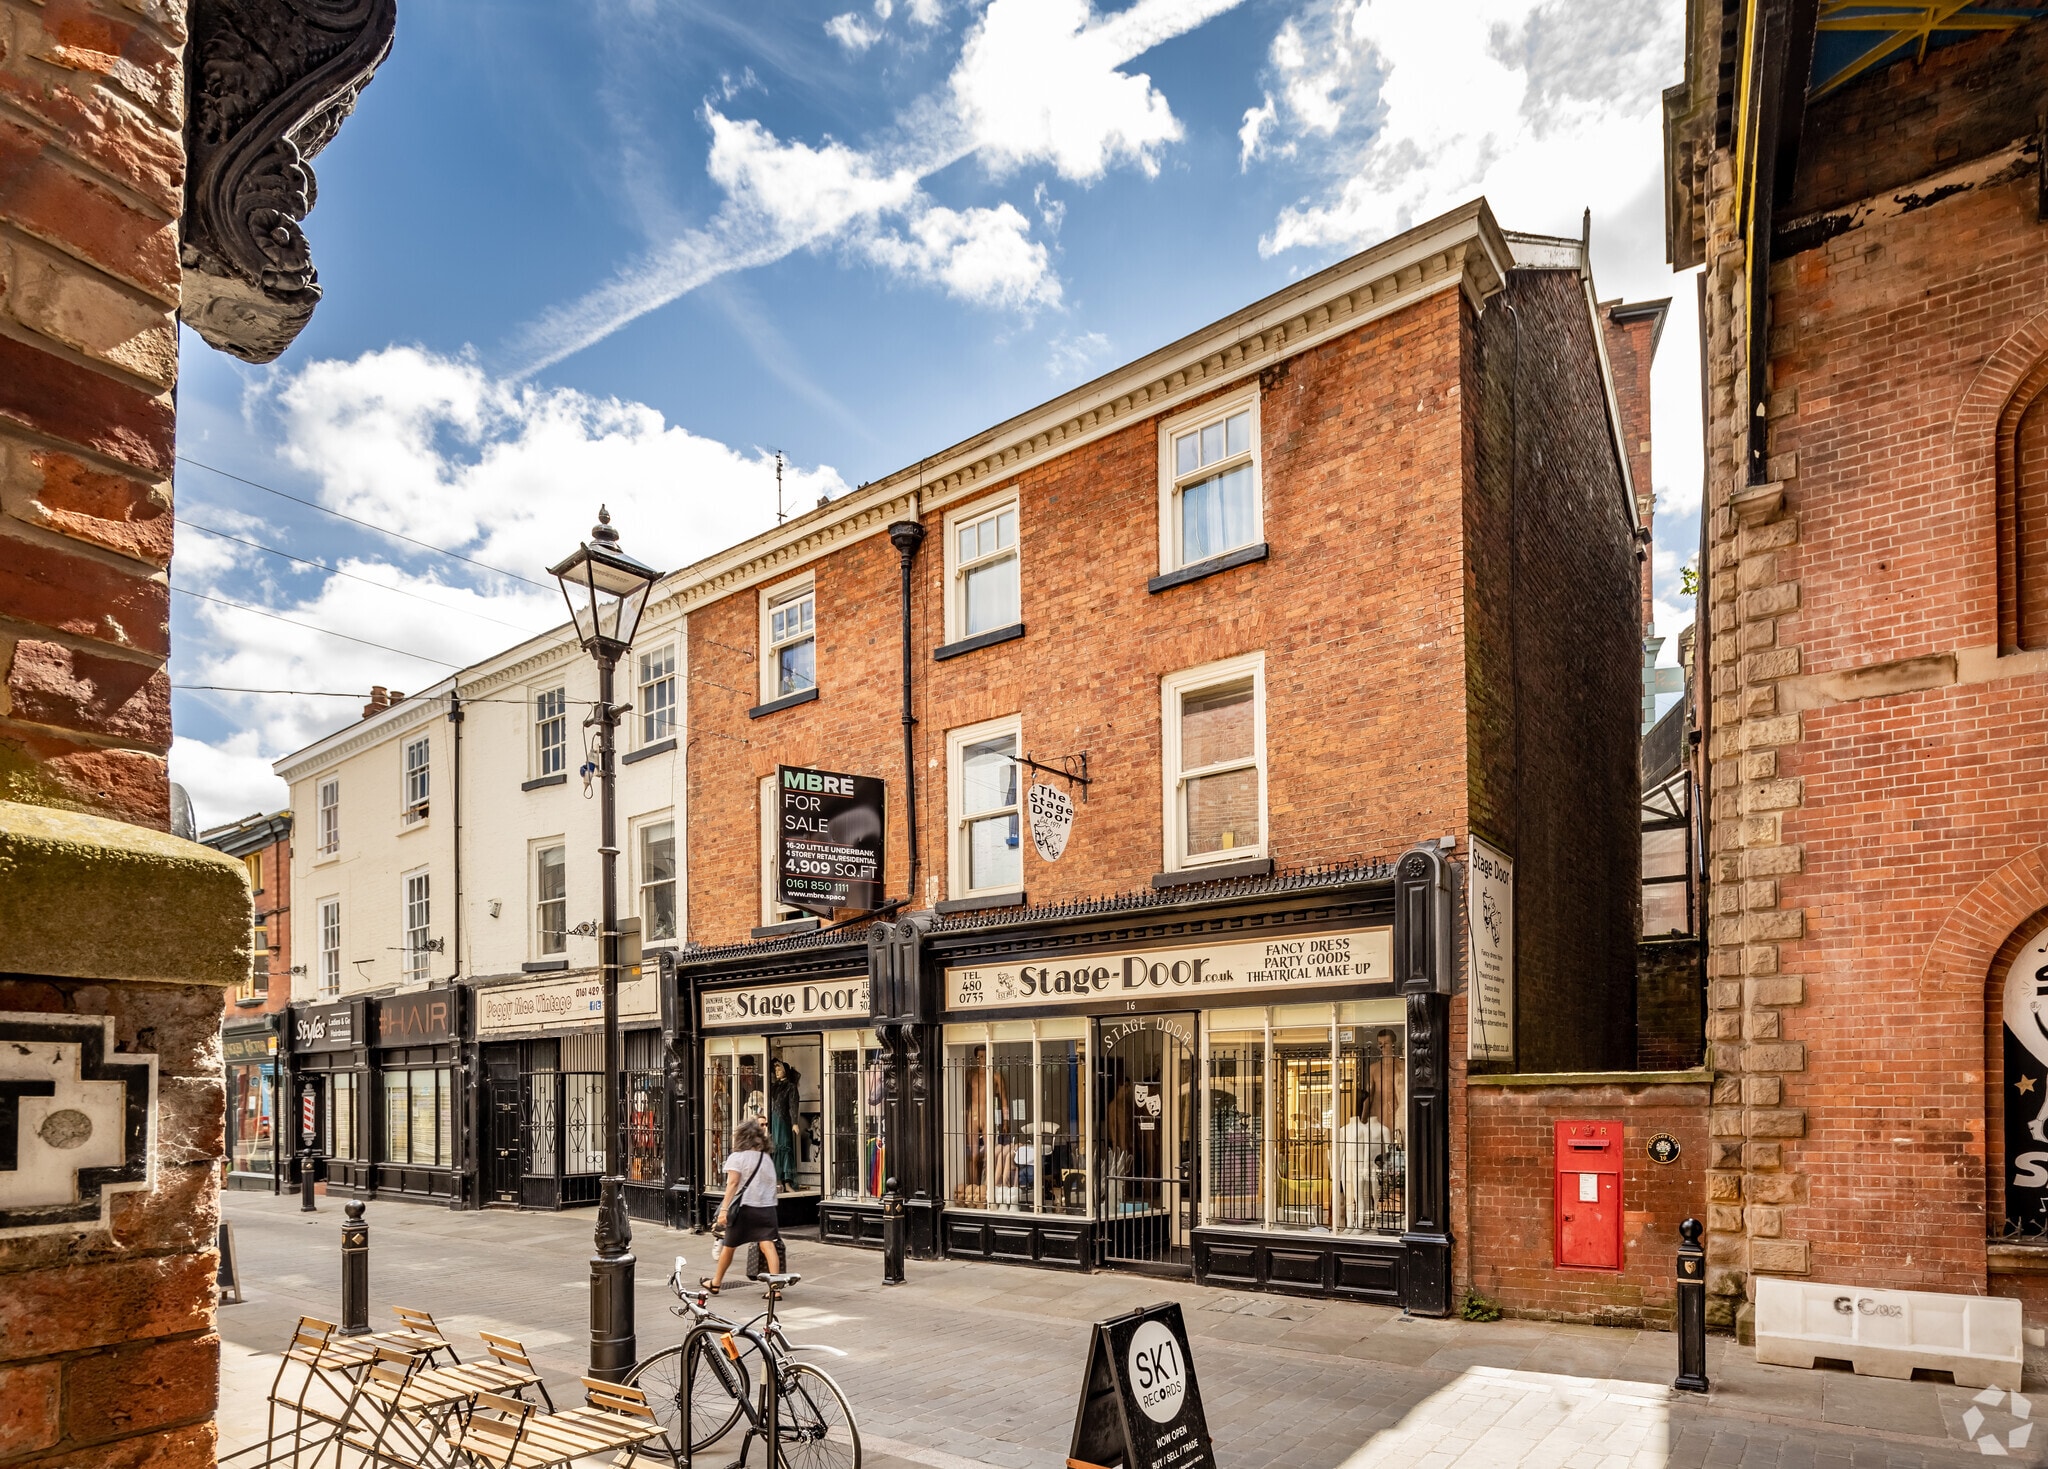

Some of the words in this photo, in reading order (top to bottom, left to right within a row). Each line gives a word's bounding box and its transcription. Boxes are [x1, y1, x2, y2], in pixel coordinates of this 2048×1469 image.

[784, 770, 854, 796] MBRE
[785, 794, 820, 812] FOR
[1039, 785, 1066, 804] The
[1030, 793, 1073, 816] Stage
[785, 815, 828, 833] SALE
[1032, 804, 1070, 825] Door
[786, 842, 806, 850] 16-20
[806, 843, 830, 853] LITTLE
[830, 845, 874, 857] UNDERBANK
[791, 850, 816, 860] STOREY
[816, 853, 877, 865] RETAIL/RESIDENTIAL
[785, 858, 831, 875] 4,909
[834, 863, 878, 879] SQ.FT
[1472, 848, 1493, 880] Stage
[1494, 860, 1510, 886] Door
[786, 878, 808, 889] 0161
[810, 881, 832, 891] 850
[835, 883, 849, 893] 1111
[787, 890, 846, 901] www.mbre.space
[1266, 942, 1305, 956] FANCY
[1310, 938, 1350, 953] DRESS
[1264, 955, 1303, 969] PARTY
[1307, 951, 1351, 965] GOODS
[1246, 967, 1311, 983] THEATRICAL
[1316, 962, 1371, 978] MAKE-UP
[576, 987, 588, 998] 0161
[588, 986, 600, 996] 429
[962, 980, 982, 991] 480
[486, 1000, 513, 1021] Peggy
[514, 997, 535, 1015] Mae
[535, 993, 573, 1016] Vintage
[736, 992, 796, 1018] Stage
[802, 985, 859, 1012] Door
[959, 992, 983, 1004] 0735
[1126, 1001, 1136, 1010] 16
[296, 1015, 326, 1047] Styles
[785, 1022, 793, 1030] 20
[1104, 1017, 1146, 1049] STAGE
[1156, 1017, 1192, 1046] DOOR
[1570, 1127, 1577, 1136] V
[1600, 1127, 1607, 1135] R
[1136, 1340, 1178, 1389] SK1
[1142, 1380, 1182, 1409] RECORDS
[1156, 1433, 1172, 1449] NOW
[1171, 1425, 1188, 1443] OPEN
[1152, 1457, 1164, 1469] BUY
[1166, 1449, 1180, 1463] SELL
[1182, 1438, 1199, 1454] TRADE
